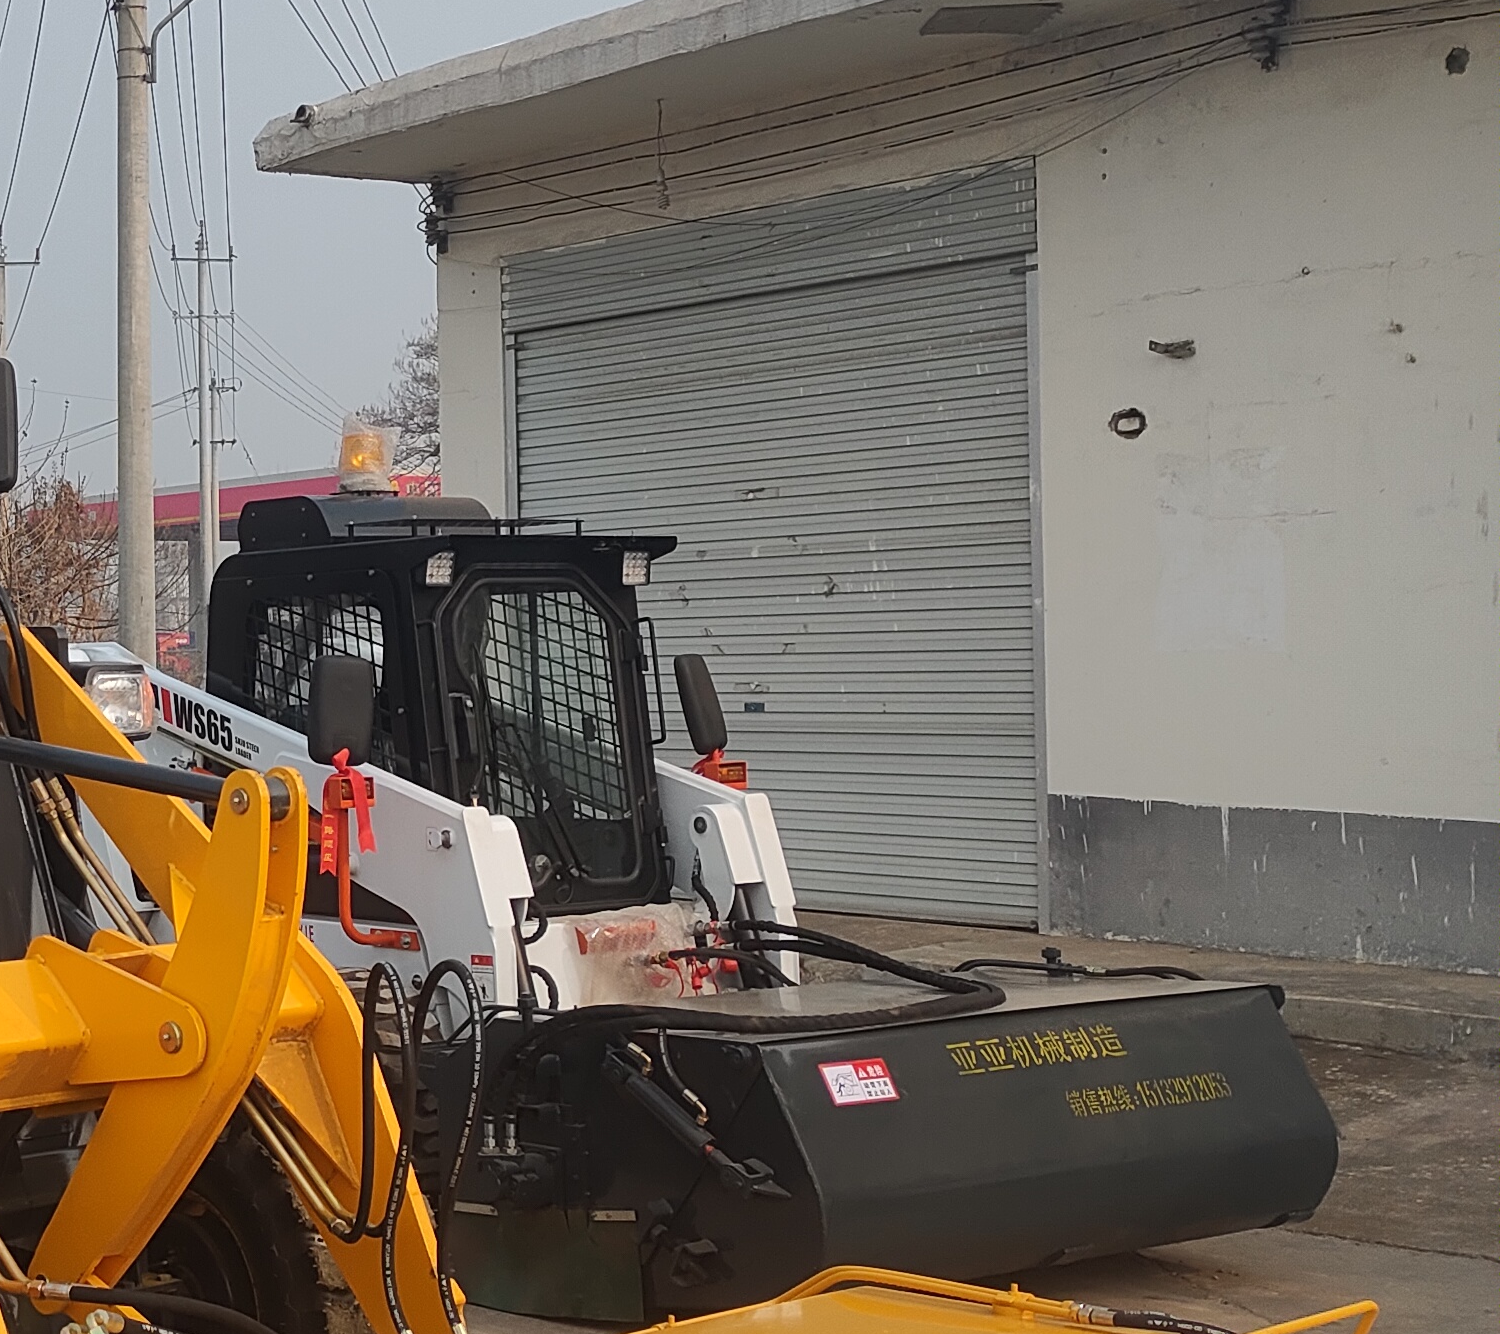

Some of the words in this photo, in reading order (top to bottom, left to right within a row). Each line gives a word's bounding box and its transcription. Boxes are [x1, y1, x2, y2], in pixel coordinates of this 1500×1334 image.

[173, 692, 233, 753] WS65
[946, 1022, 1128, 1076] 亚亚机械制造
